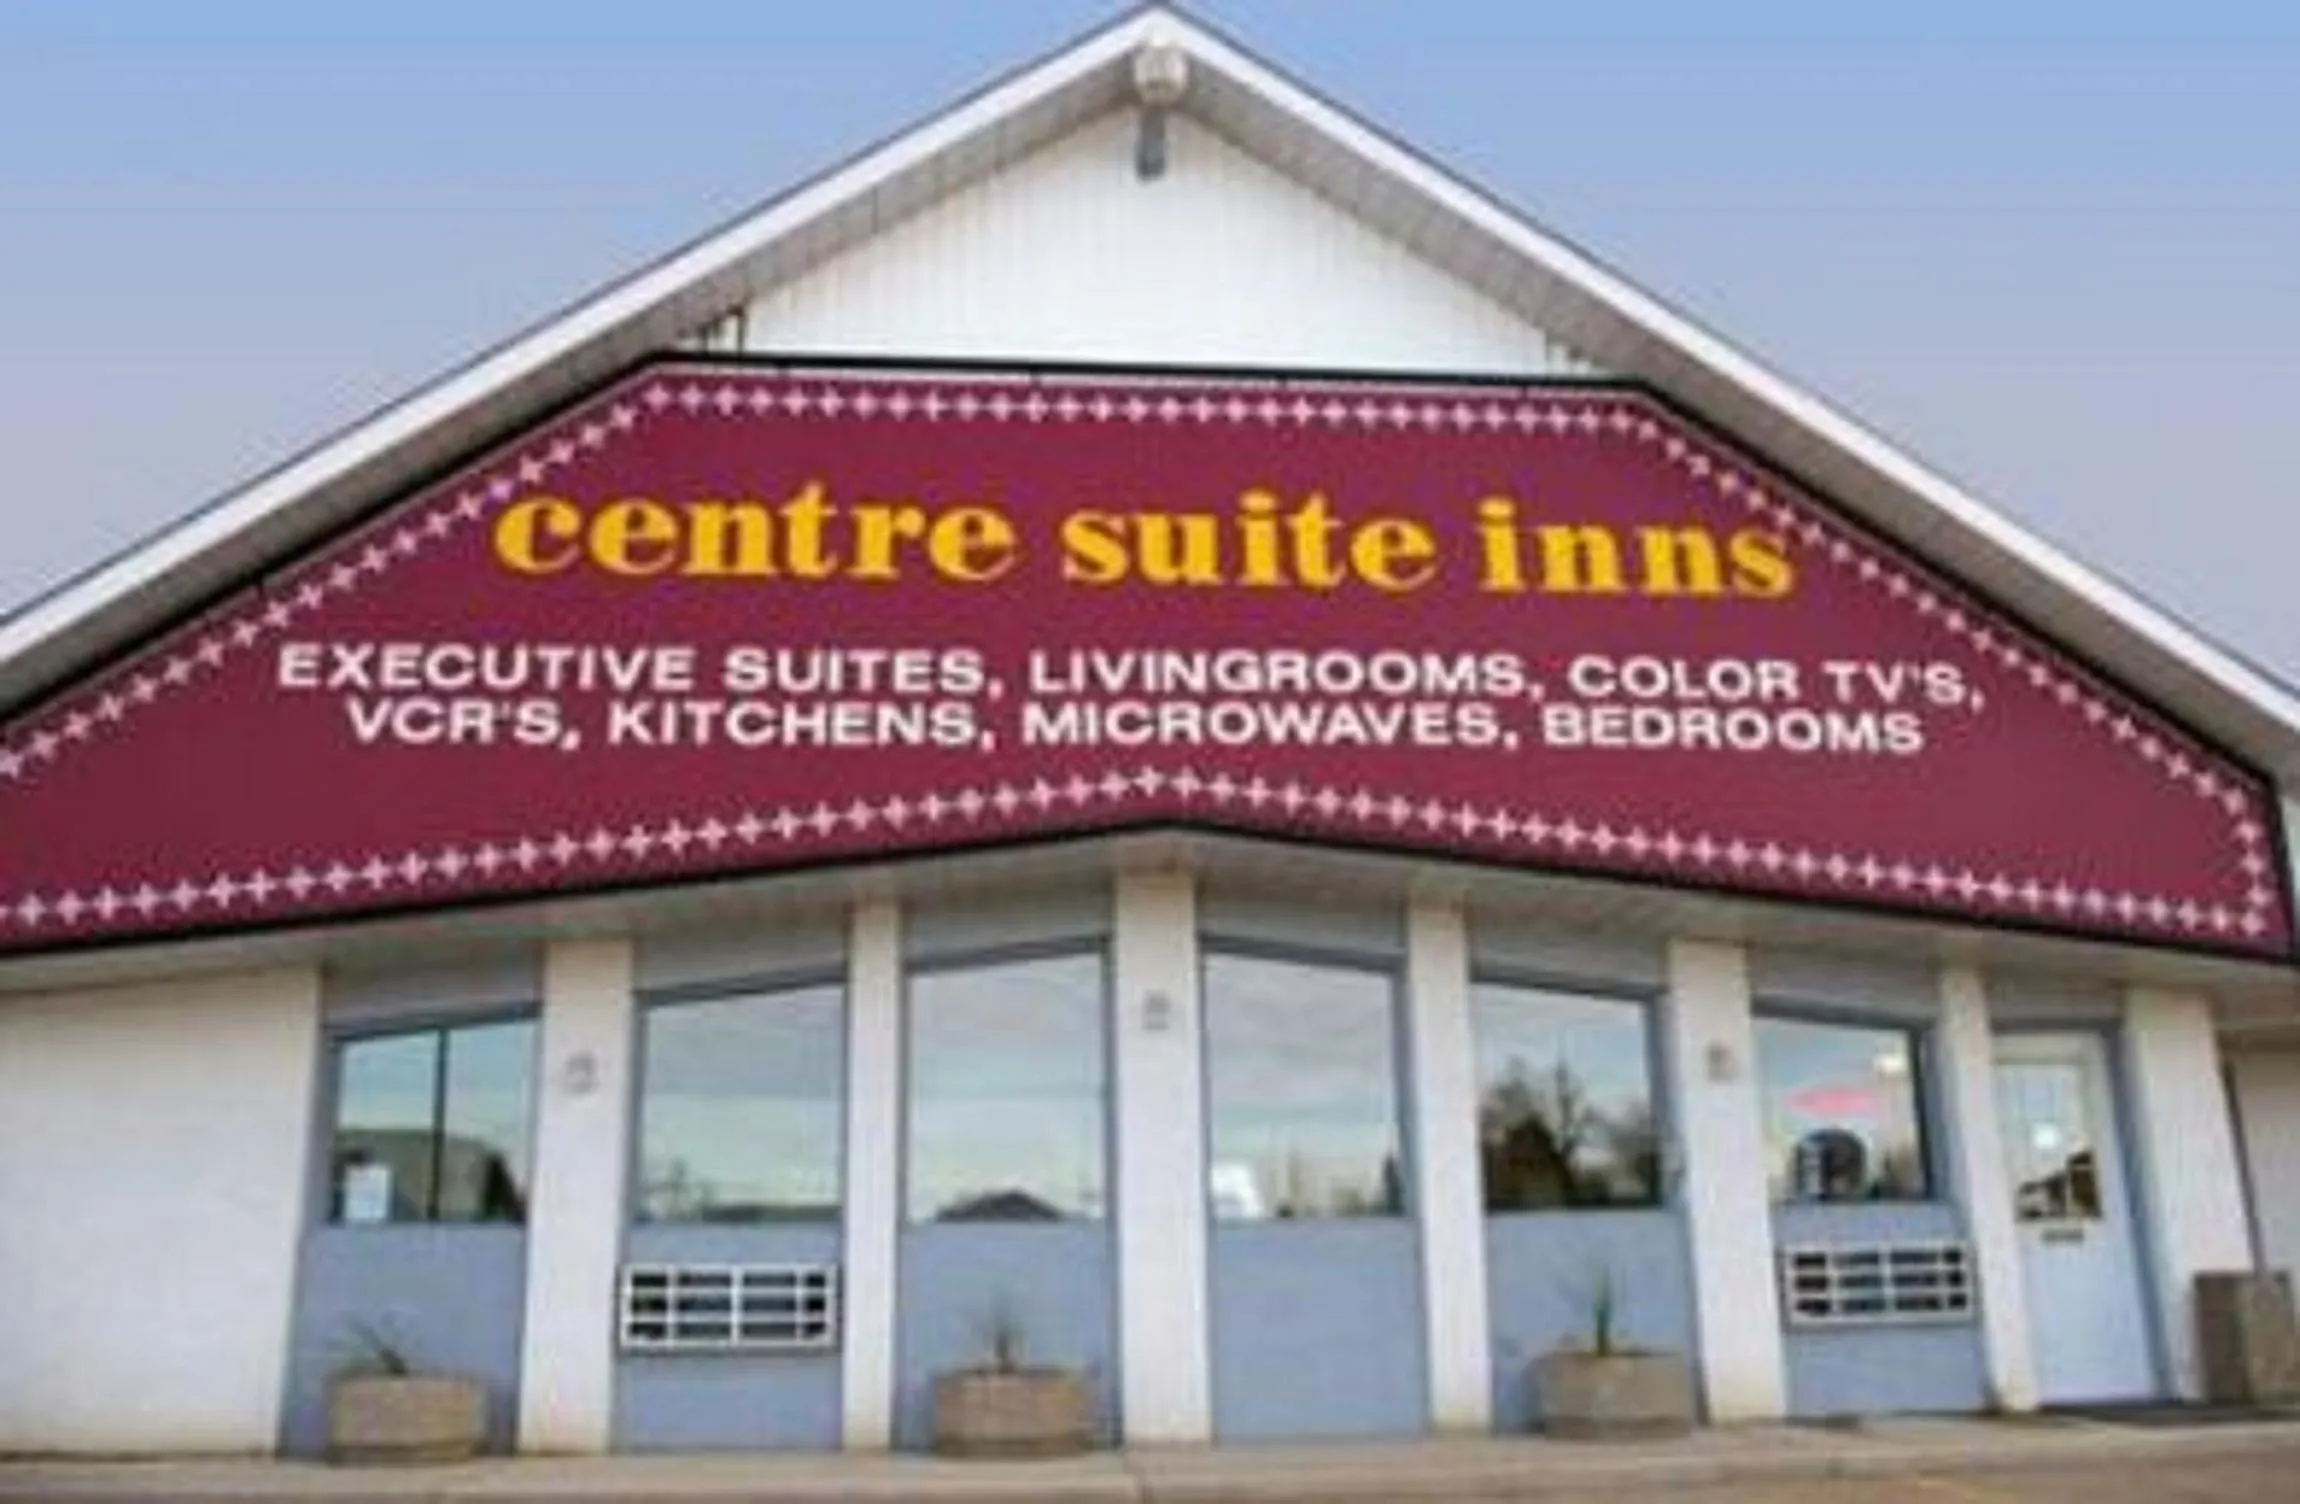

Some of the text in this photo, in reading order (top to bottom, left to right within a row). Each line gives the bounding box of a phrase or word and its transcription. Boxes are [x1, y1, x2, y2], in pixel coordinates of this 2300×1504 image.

[494, 481, 1797, 598] centre suite inns
[278, 643, 1986, 713] EXECUTIVE SUITES, LIVINGROOMS, COLOR TV'S,
[346, 699, 1924, 756] VCR'S, KITCHENS, MICROWAVES, BEDROOMS
